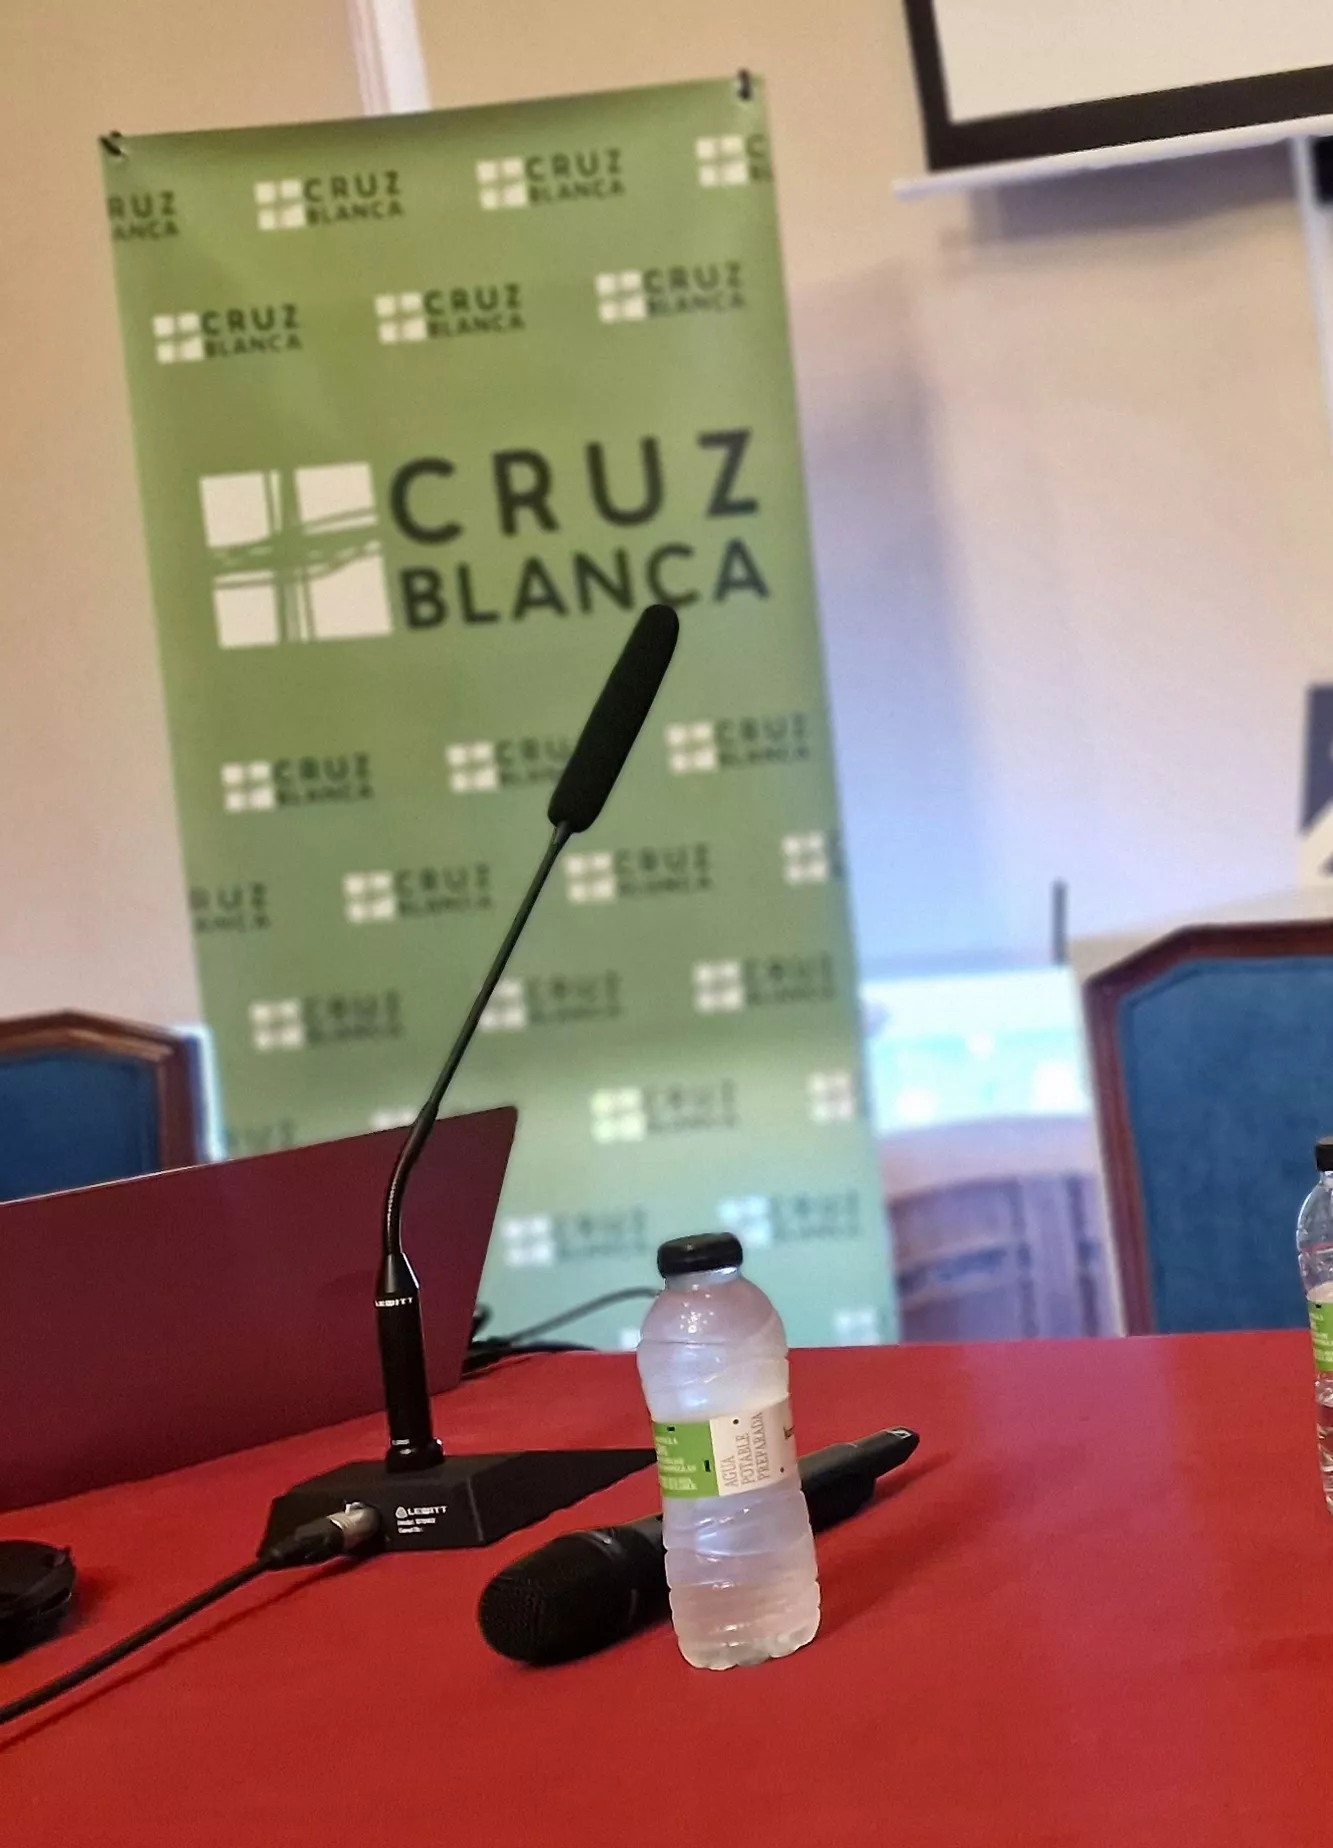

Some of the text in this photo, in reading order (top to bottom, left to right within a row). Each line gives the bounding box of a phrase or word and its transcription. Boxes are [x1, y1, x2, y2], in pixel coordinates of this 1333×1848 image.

[525, 148, 621, 181] CRUZ
[303, 170, 401, 202] CRUZ
[306, 200, 405, 225] BLANCA
[644, 260, 741, 292] CRUZ
[423, 282, 520, 315] CRUZ
[202, 303, 299, 335] CRUZ
[204, 333, 303, 358] BLANCA
[388, 427, 759, 545] CRUZ
[400, 537, 770, 630] BLANCA
[496, 736, 576, 765] CRU
[735, 1432, 756, 1486] POTABLE
[750, 1411, 771, 1482] PREPARADA
[720, 1455, 739, 1490] AGUA
[407, 1505, 448, 1516] LEWITT
